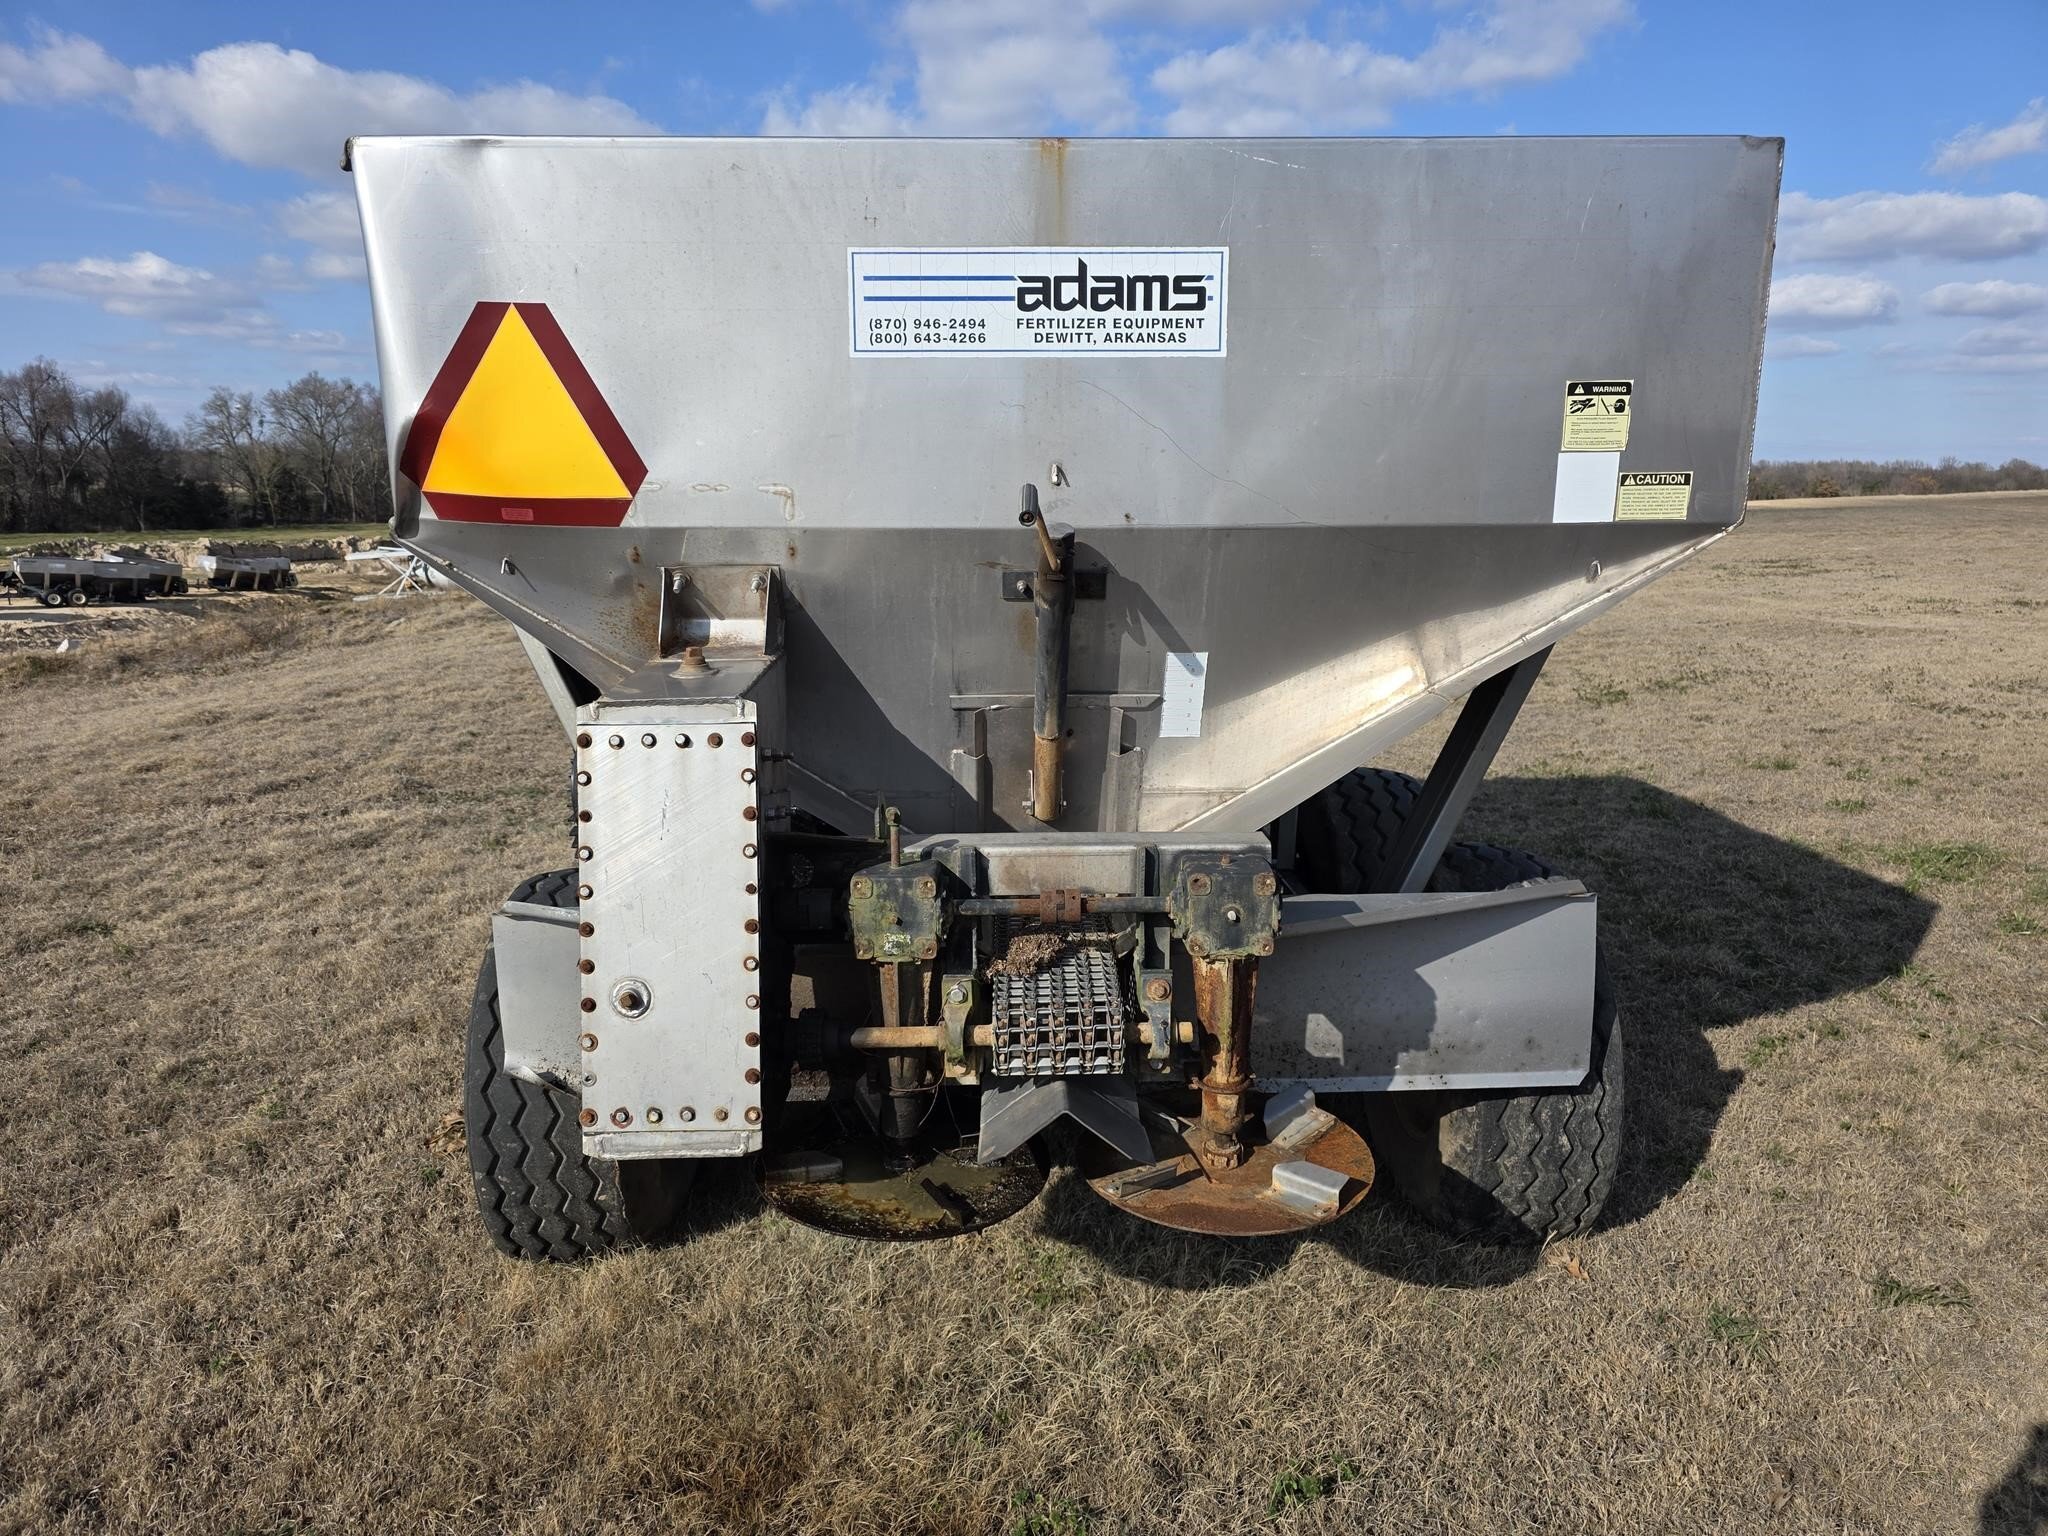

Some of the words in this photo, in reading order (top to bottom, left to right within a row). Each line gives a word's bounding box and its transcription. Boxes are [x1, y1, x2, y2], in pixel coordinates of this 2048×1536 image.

[1016, 257, 1207, 312] adams
[868, 318, 908, 331] (870)
[913, 318, 987, 330] 946-2494
[1016, 318, 1107, 330] FERTILIZER
[1112, 318, 1206, 330] EQUIPMENT
[868, 332, 908, 345] (800)
[913, 332, 987, 344] 643-4266
[1034, 332, 1098, 346] DEWITT,
[1103, 332, 1188, 344] ARKANSAS
[1592, 385, 1627, 393] WARNING
[1636, 474, 1686, 485] CAUTION
